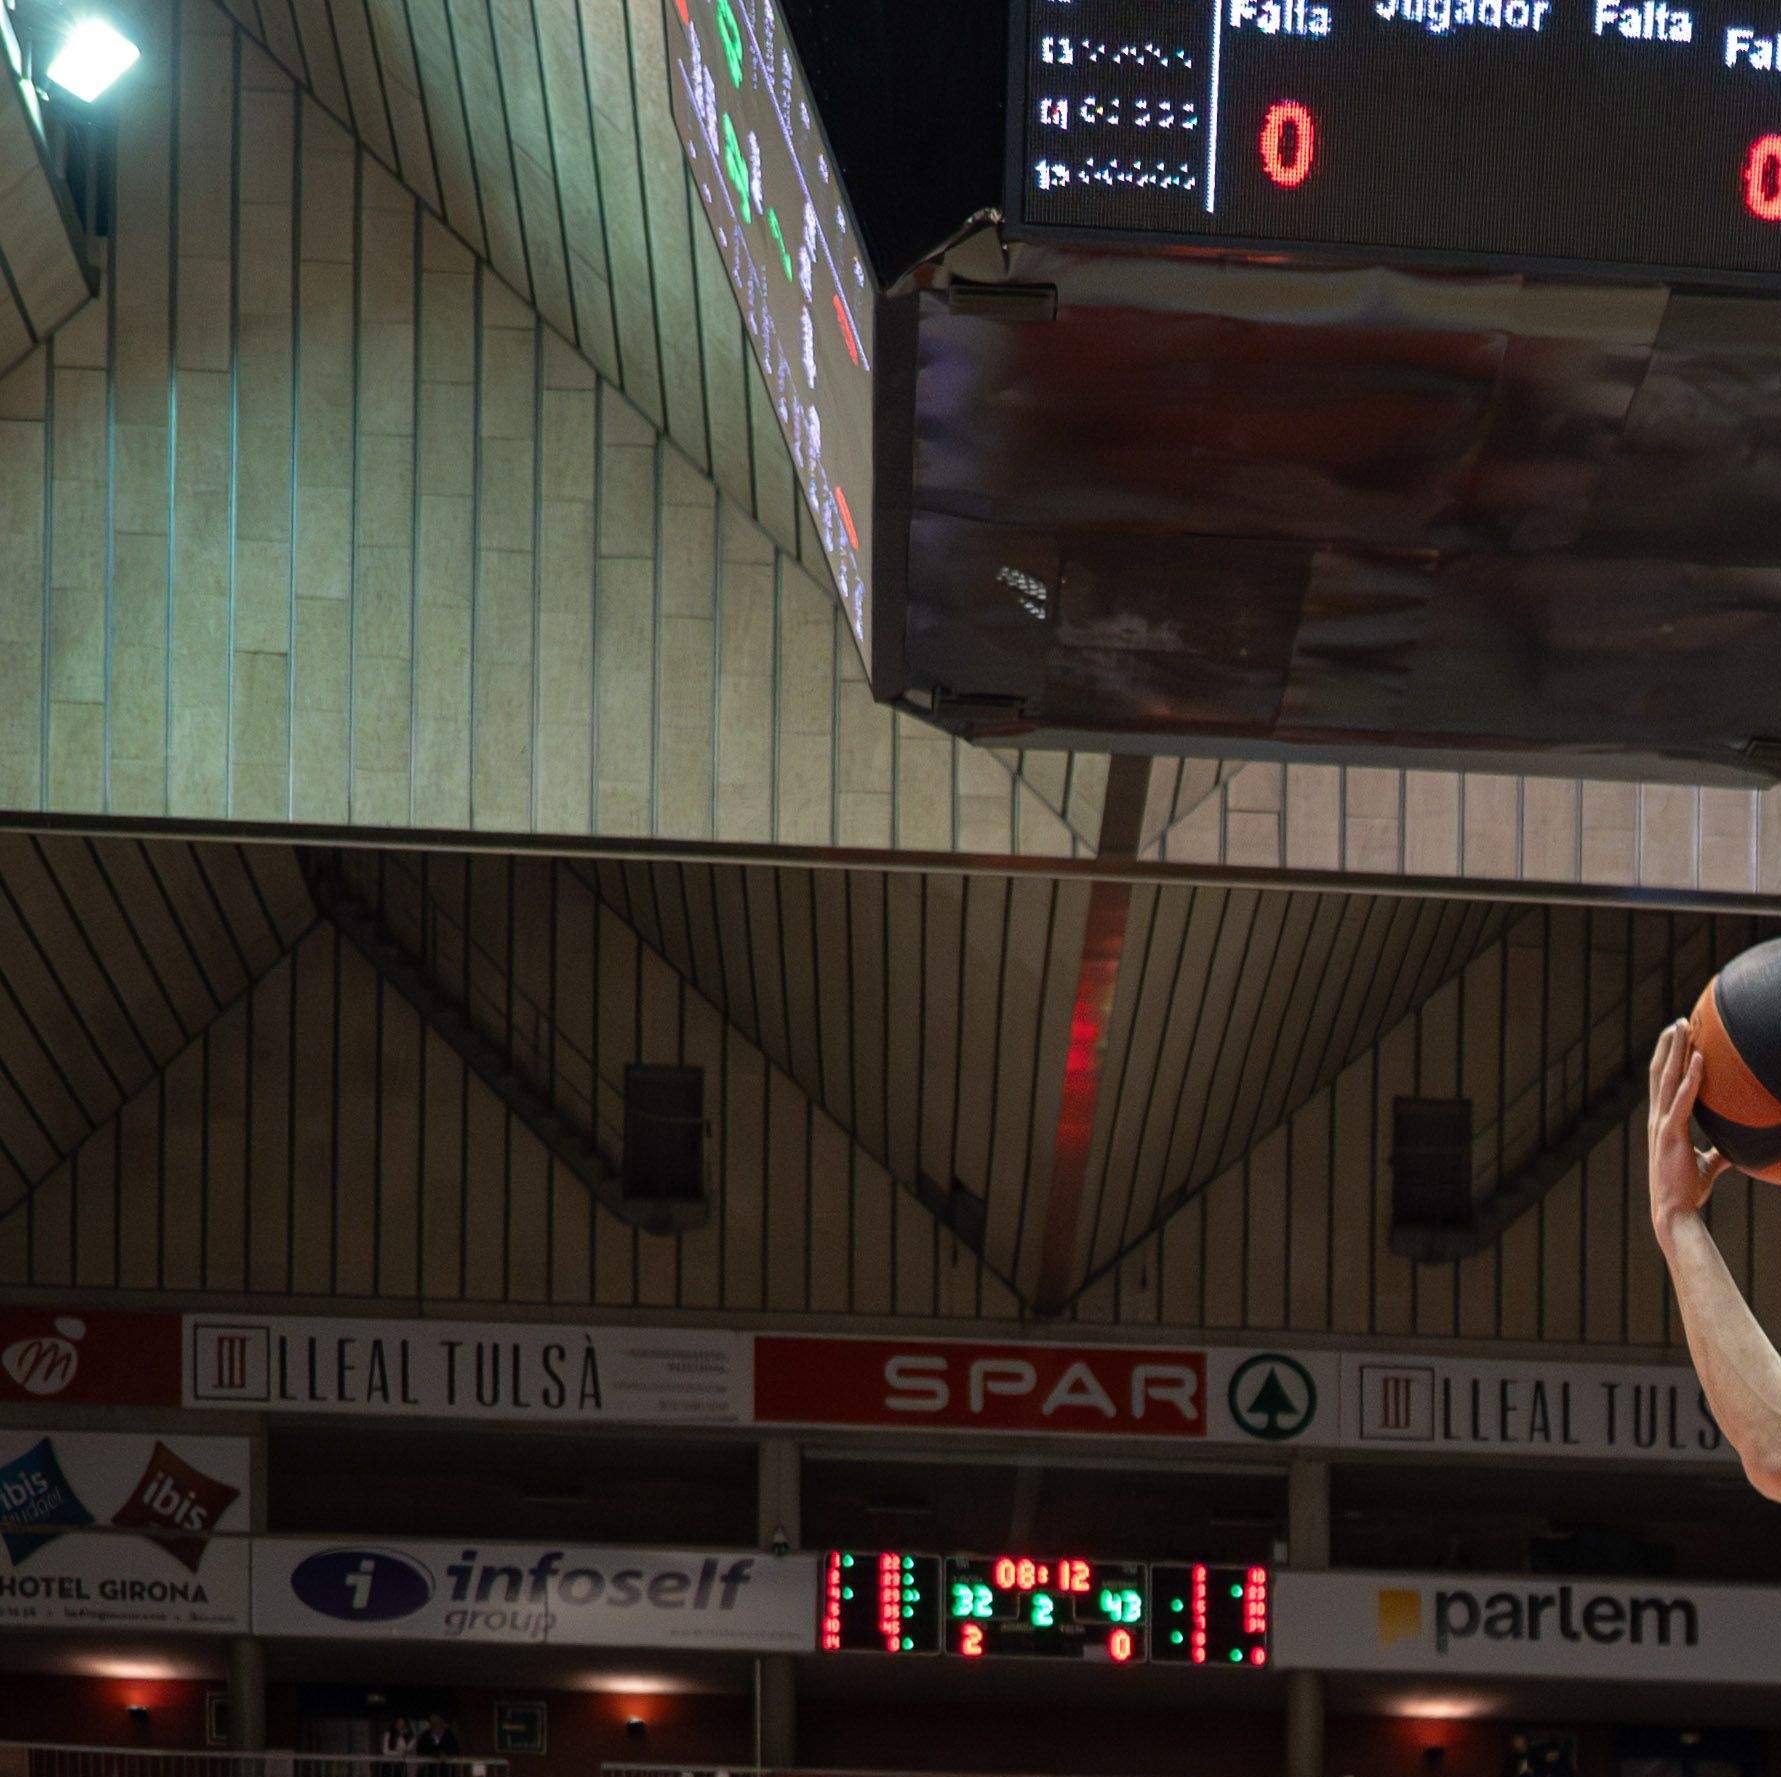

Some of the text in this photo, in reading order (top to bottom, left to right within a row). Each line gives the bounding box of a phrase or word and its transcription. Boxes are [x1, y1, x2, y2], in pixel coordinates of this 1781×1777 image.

[1229, 0, 1331, 37] Falta
[1594, 0, 1693, 43] Falta
[1260, 99, 1315, 190] 0
[278, 1335, 419, 1405] LLEAL
[440, 1332, 602, 1410] TULSÀ
[884, 1354, 1199, 1421] SPAR
[1442, 1376, 1580, 1444] LLEAL
[141, 1470, 208, 1533] ibis
[98, 1579, 209, 1603] GIRONA
[445, 1550, 755, 1612] infoself
[951, 1583, 993, 1618] 32
[444, 1604, 557, 1638] group
[1030, 1592, 1054, 1627] 2
[1100, 1588, 1142, 1622] 43
[1436, 1586, 1700, 1655] parlem
[961, 1621, 984, 1656] 2
[1108, 1628, 1132, 1661] 0
